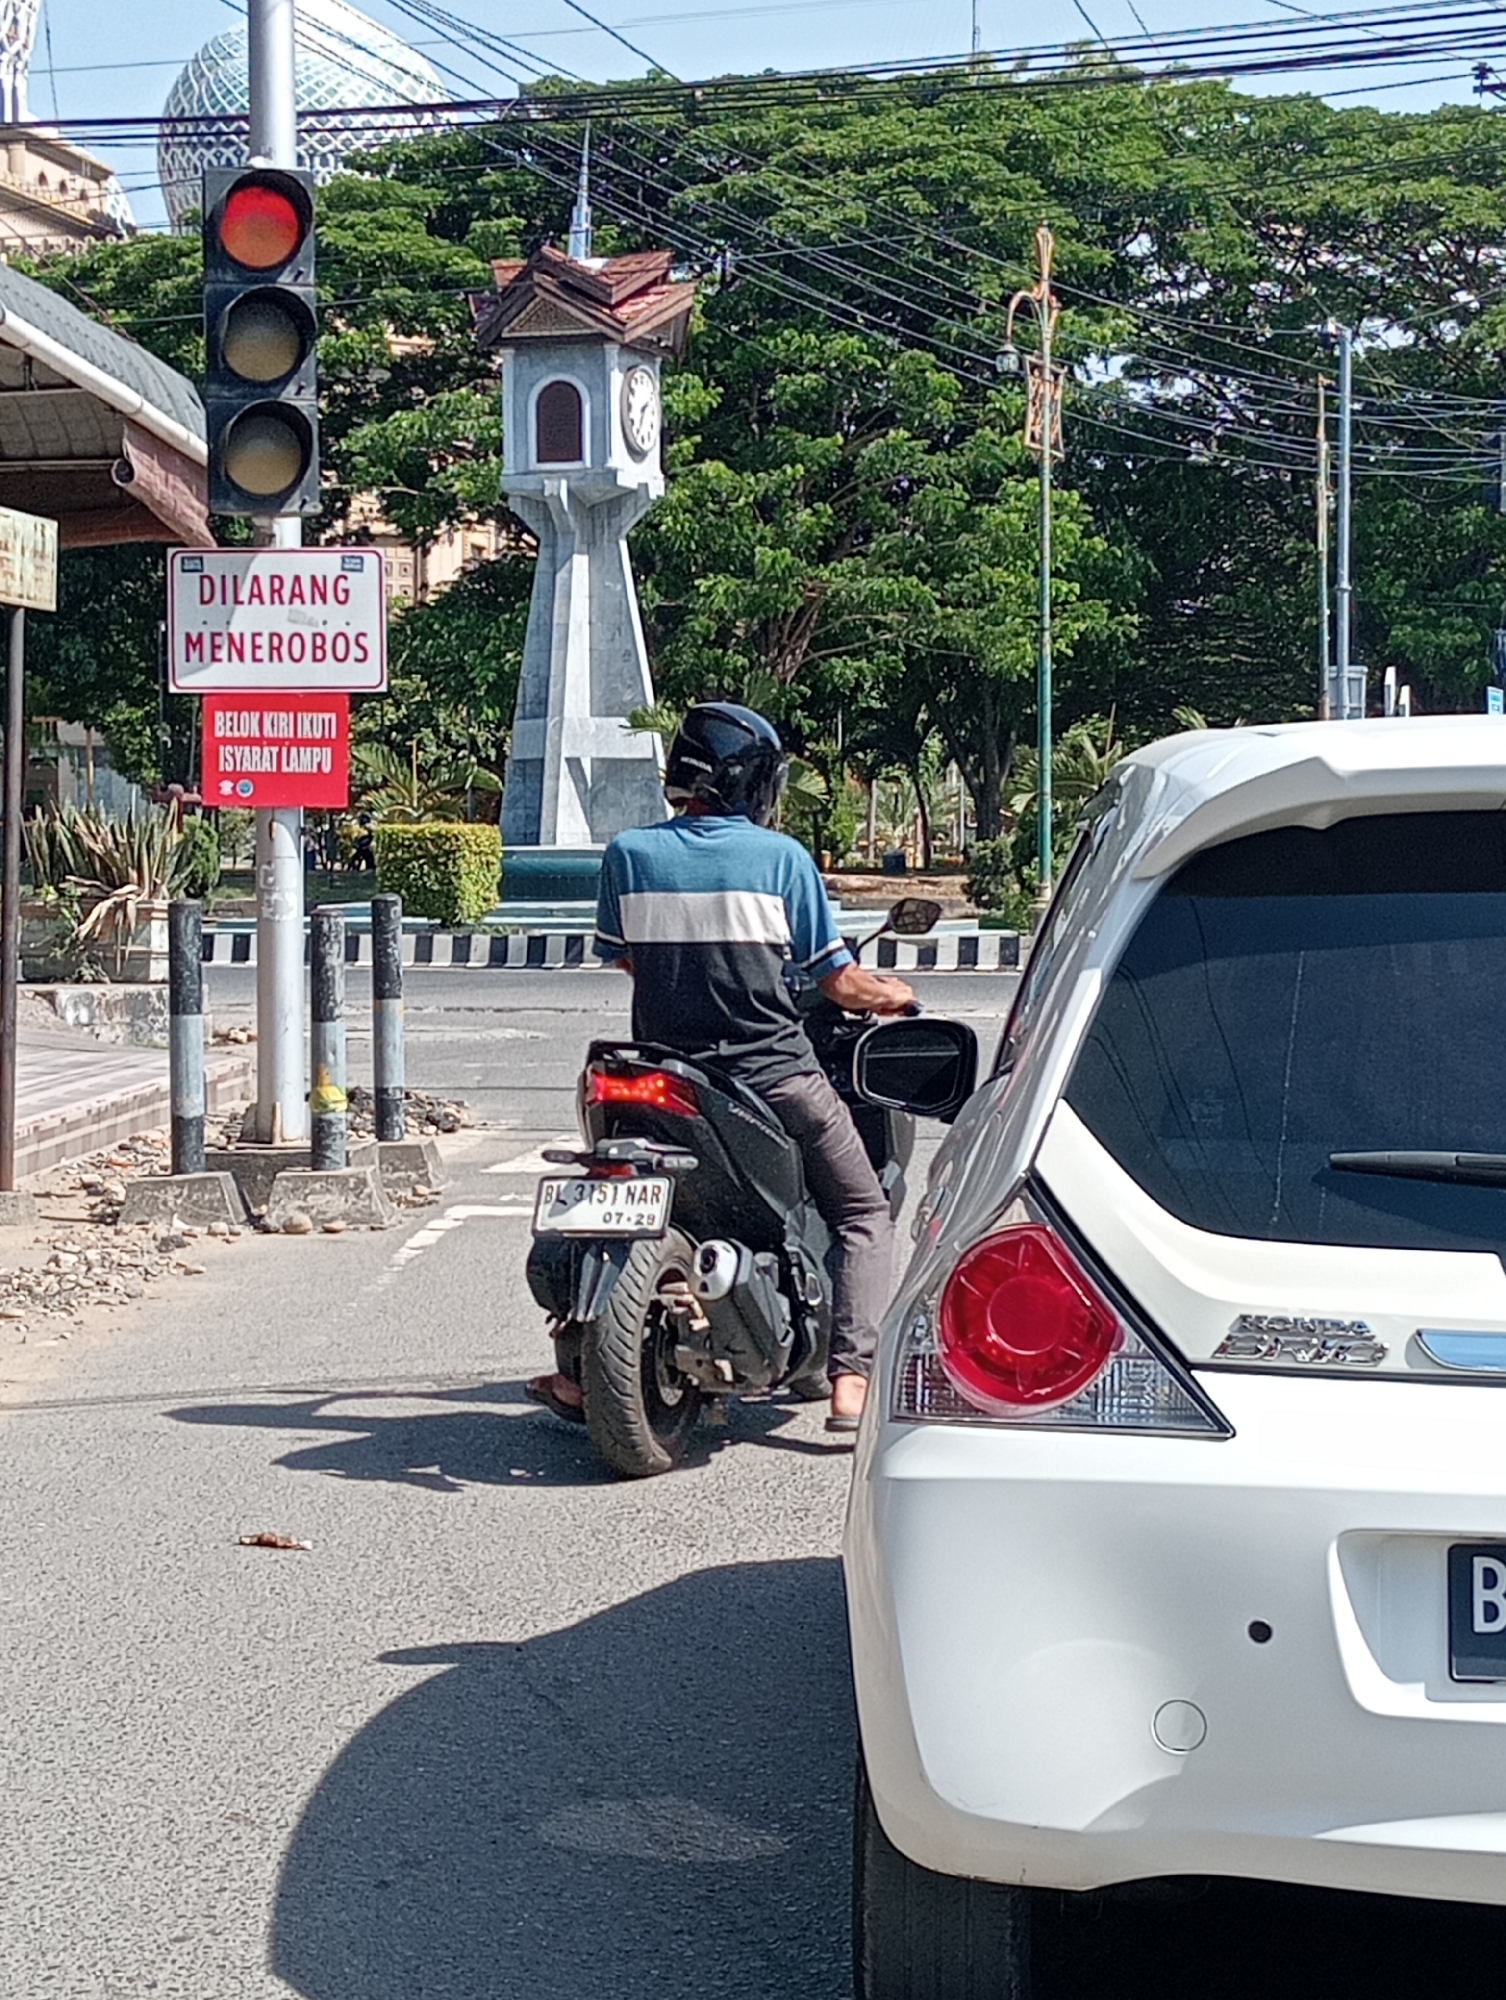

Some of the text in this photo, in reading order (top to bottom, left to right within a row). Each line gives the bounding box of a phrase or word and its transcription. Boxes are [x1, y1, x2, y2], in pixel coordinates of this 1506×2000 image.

[199, 574, 351, 606] DILARANG
[183, 631, 370, 664] MENEROBOS
[214, 711, 337, 739] BELOK KIRI IKUTI
[218, 745, 332, 773] ISYARAT LAMPU
[625, 1184, 662, 1206] NAR
[1230, 1313, 1374, 1339] HONDA
[1472, 1555, 1506, 1633] B
